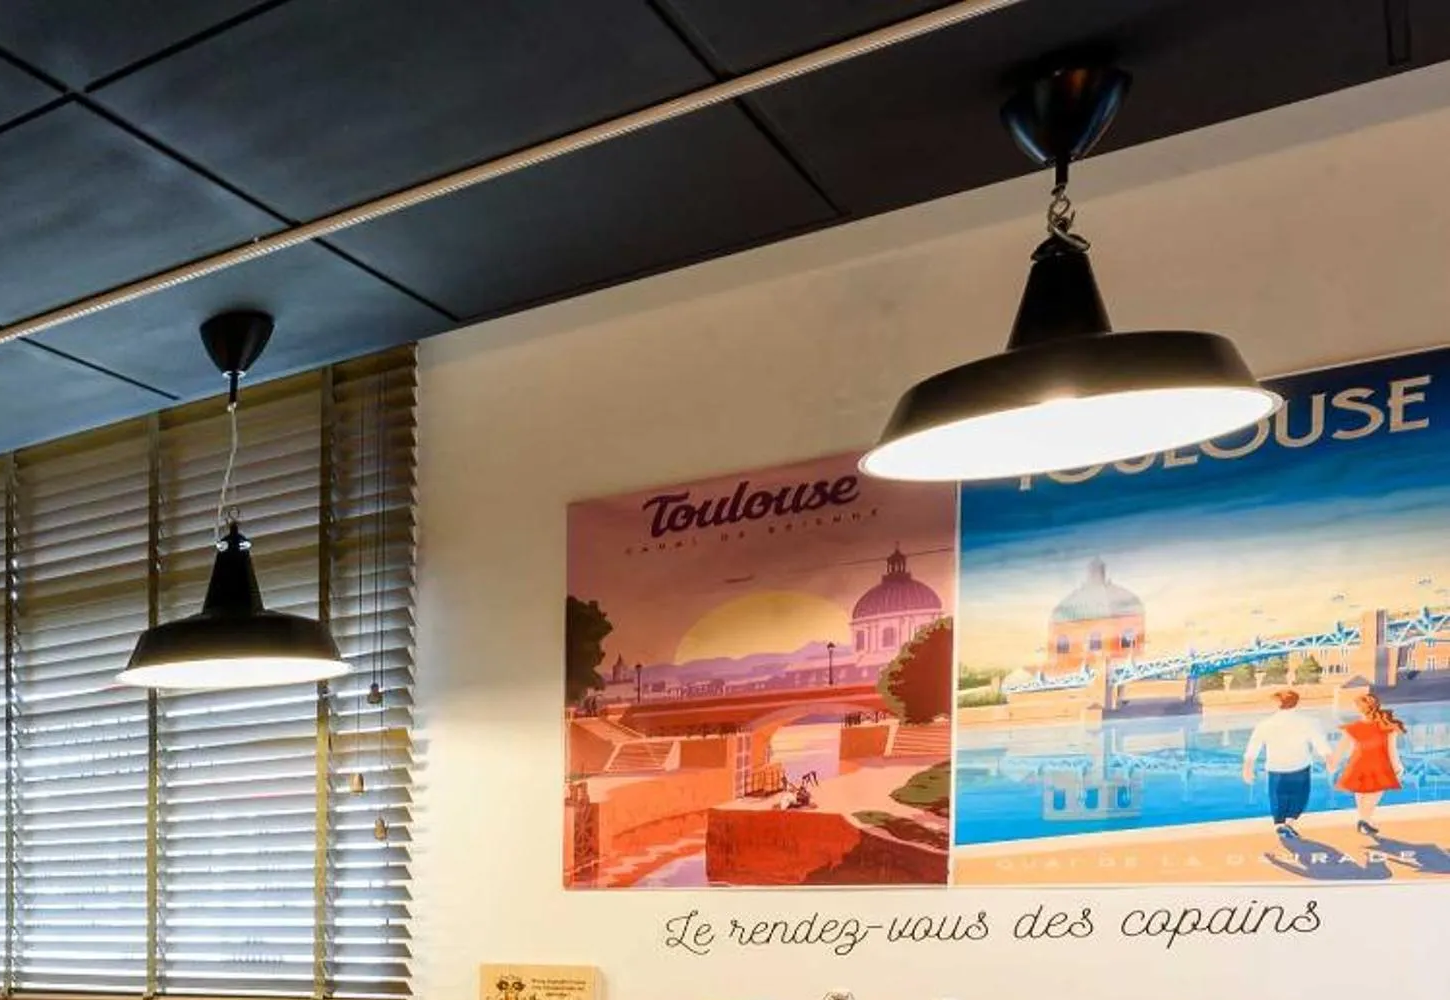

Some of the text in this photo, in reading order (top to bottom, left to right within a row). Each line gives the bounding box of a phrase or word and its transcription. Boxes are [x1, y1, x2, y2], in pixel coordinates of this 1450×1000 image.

[1018, 375, 1432, 491] OUSE
[643, 475, 861, 538] Toulouse
[1225, 850, 1417, 865] DURADE
[665, 899, 1322, 956] Le rendez-vous des copains
